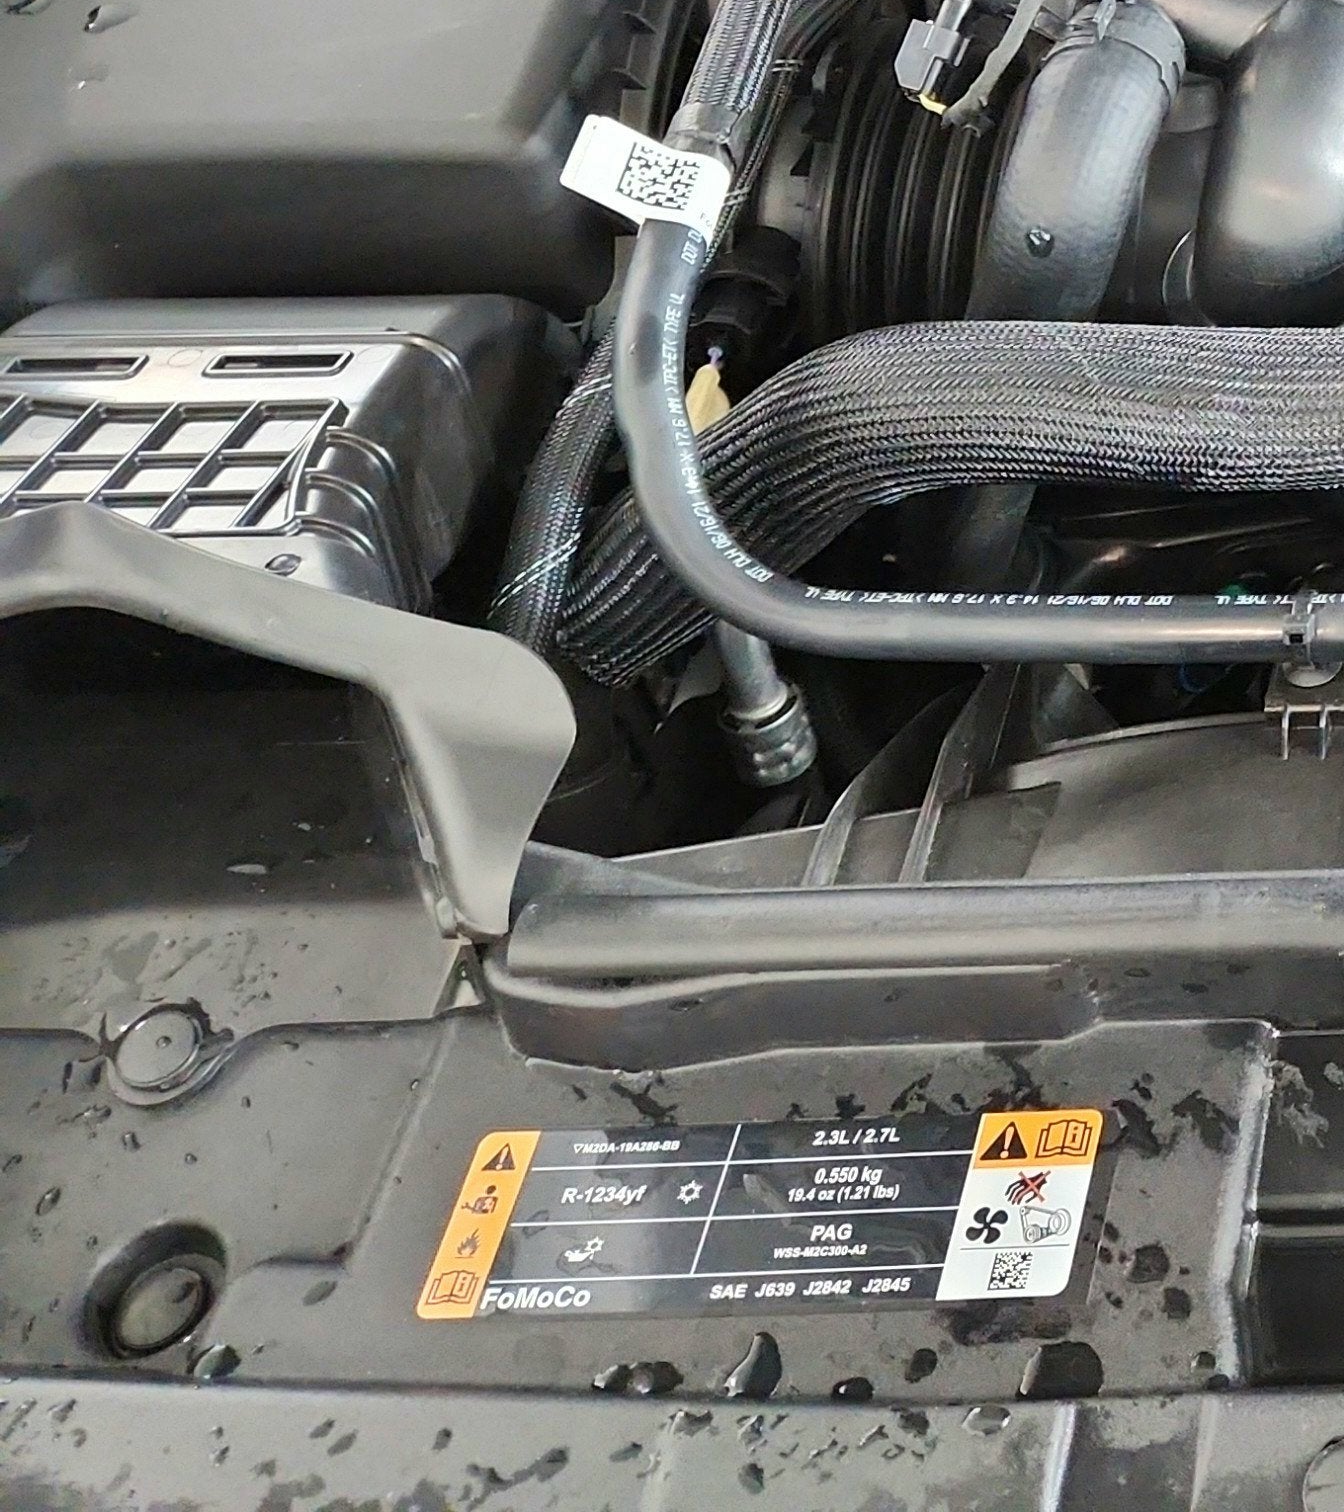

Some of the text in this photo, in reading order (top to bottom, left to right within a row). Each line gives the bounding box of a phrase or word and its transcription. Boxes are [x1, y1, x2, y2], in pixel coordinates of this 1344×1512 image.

[672, 416, 693, 451] 17.6
[812, 1129, 850, 1146] 2.3L
[852, 1129, 863, 1145] /
[863, 1127, 900, 1143] 2.7L
[814, 1165, 883, 1186] 0.550 kg
[561, 1184, 647, 1206] R-1234yf
[788, 1183, 900, 1204] 19.4 oz (1.21 lbs)
[810, 1222, 853, 1242] PAG
[479, 1285, 591, 1310] FoMoCo
[709, 1277, 912, 1300] SAE J639 J2842 J2845
